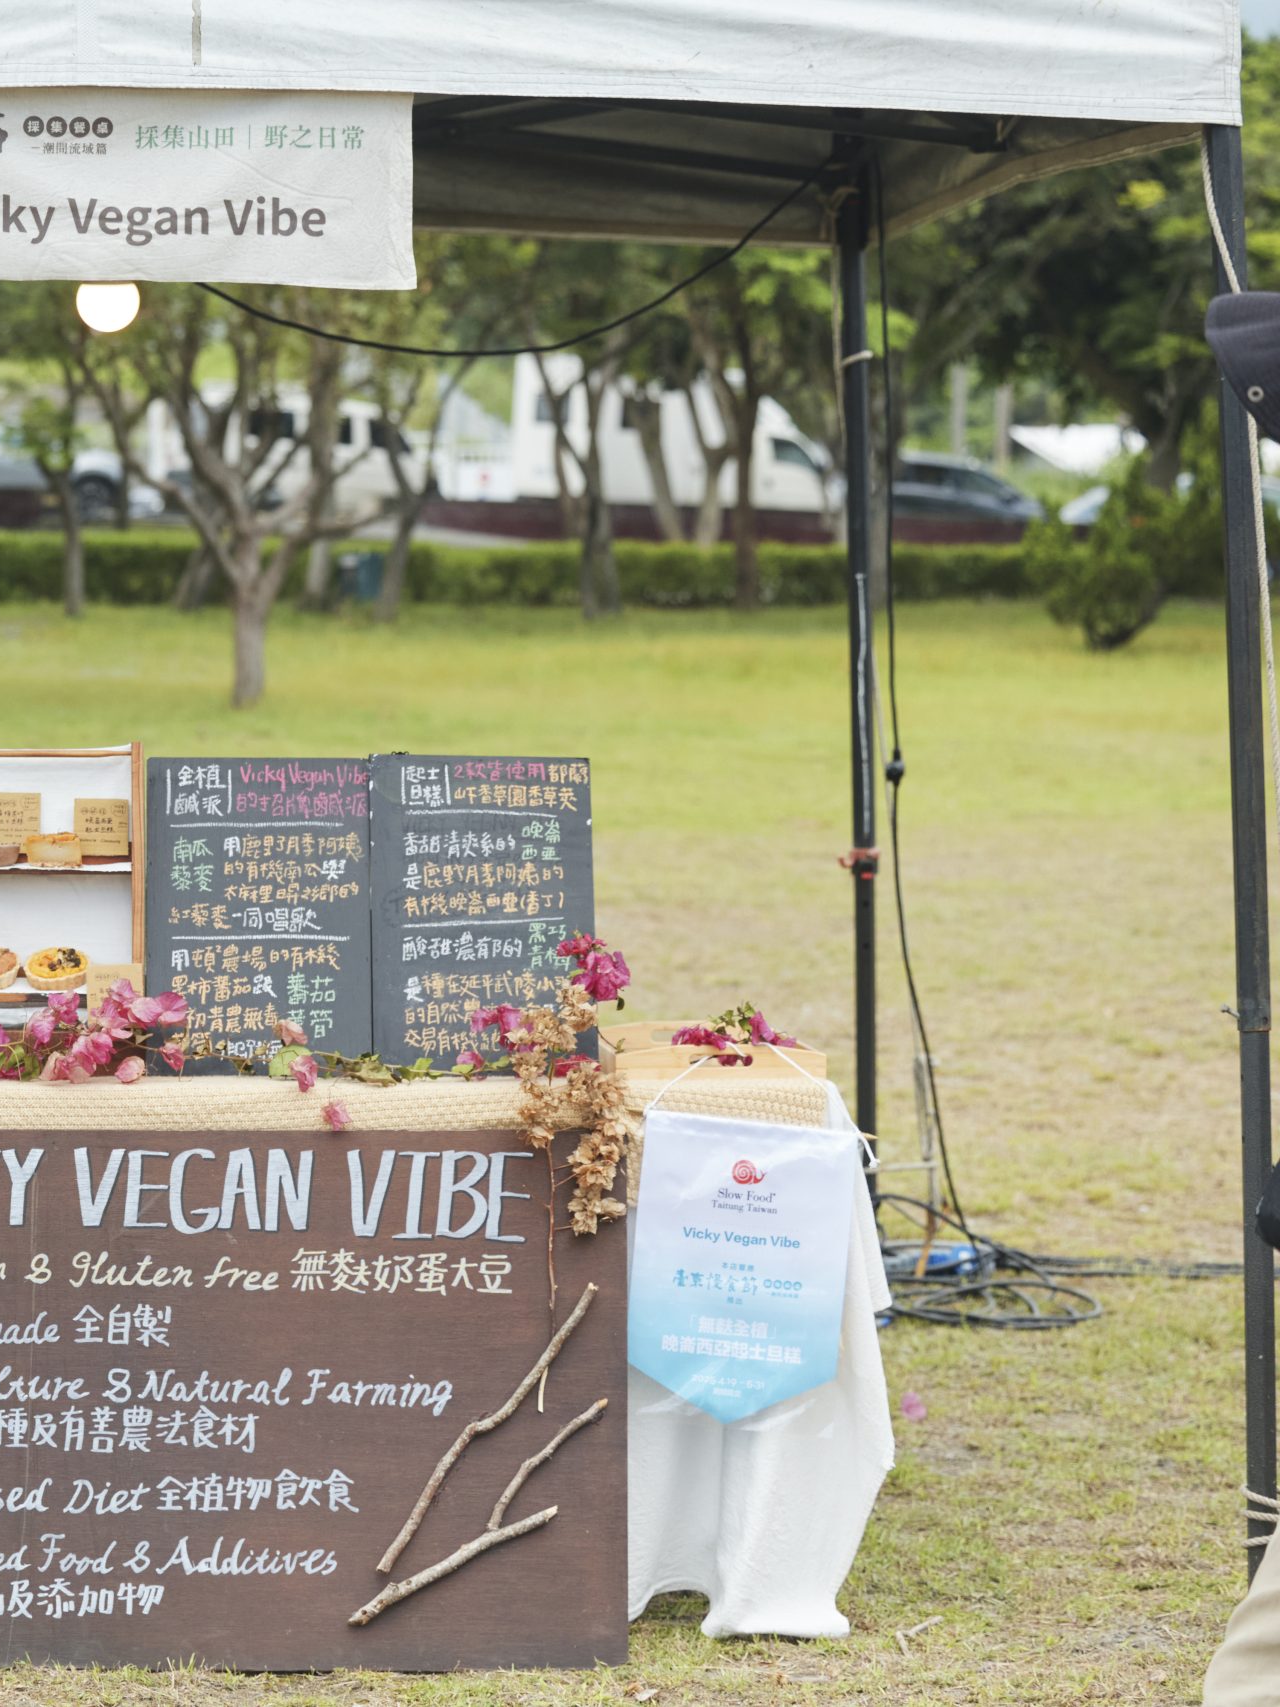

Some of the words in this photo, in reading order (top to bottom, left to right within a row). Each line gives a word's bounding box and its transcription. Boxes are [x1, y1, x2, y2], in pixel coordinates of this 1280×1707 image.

[135, 124, 235, 149] 採集山田
[264, 124, 365, 150] 野之日常
[68, 197, 210, 246] Vegan
[223, 195, 327, 237] Vibe
[240, 764, 287, 793] Vicky
[73, 1147, 314, 1235] VEGAN
[347, 1149, 534, 1242] VIBE
[712, 1199, 745, 1213] Taitung
[746, 1203, 778, 1214] Taiwan
[717, 1188, 744, 1200] Slow
[683, 1226, 721, 1243] Vicky
[724, 1230, 767, 1247] Vegan
[770, 1235, 800, 1249] Vibe
[204, 1256, 280, 1291] free
[73, 1304, 172, 1347] 全自製
[137, 1367, 292, 1406] Natural
[301, 1367, 453, 1417] Farming
[63, 1479, 152, 1516] Diet
[156, 1468, 360, 1514] 全植物飲食
[38, 1533, 118, 1575] Food
[156, 1536, 339, 1577] Additives
